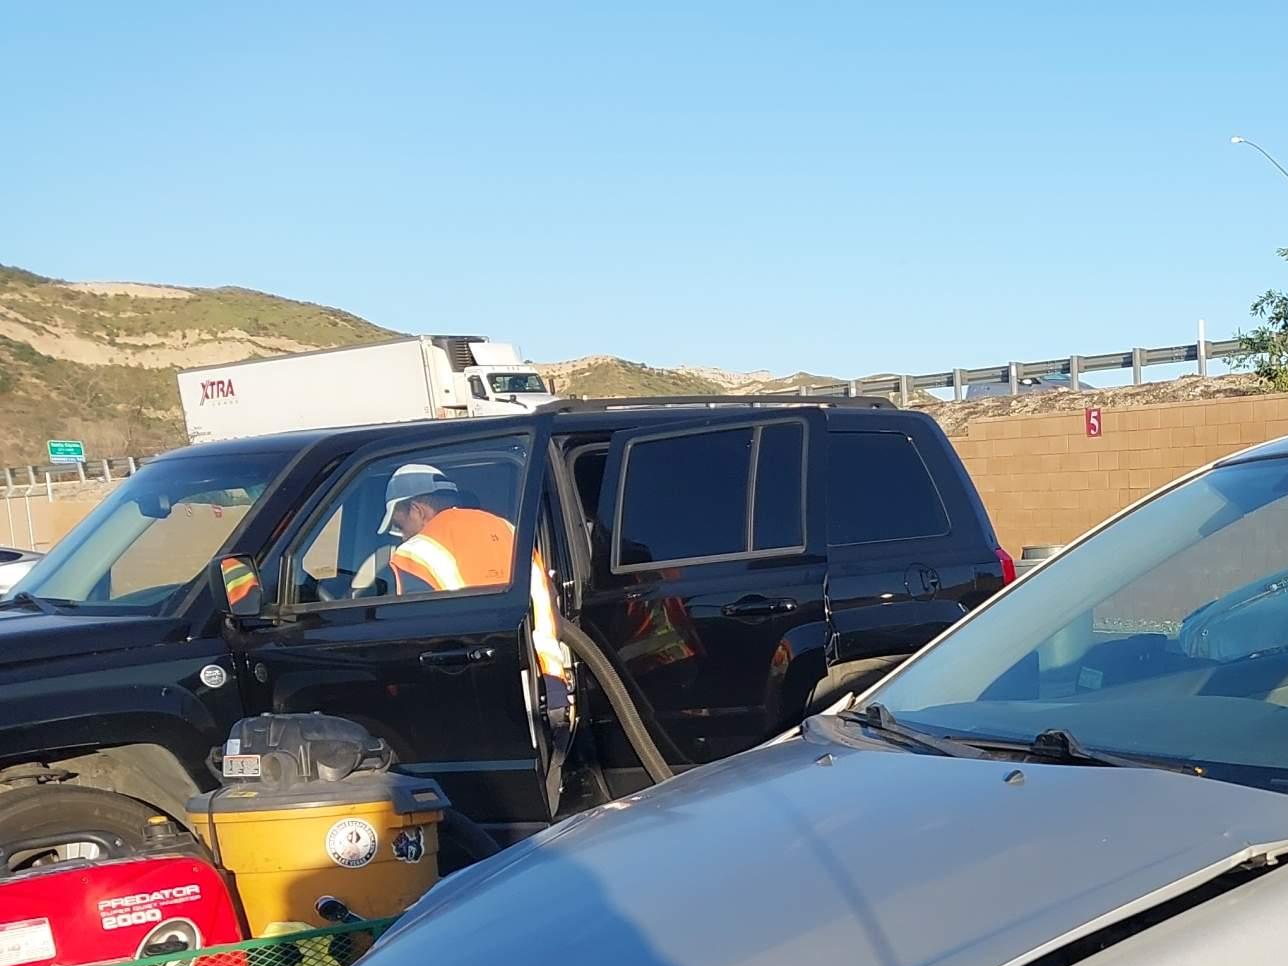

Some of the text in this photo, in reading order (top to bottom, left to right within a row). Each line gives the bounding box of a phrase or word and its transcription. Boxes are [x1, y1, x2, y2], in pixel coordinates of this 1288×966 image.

[200, 379, 235, 406] XTRA
[1090, 410, 1099, 434] 5
[98, 884, 201, 911] PREDATOR
[102, 908, 162, 930] 2000
